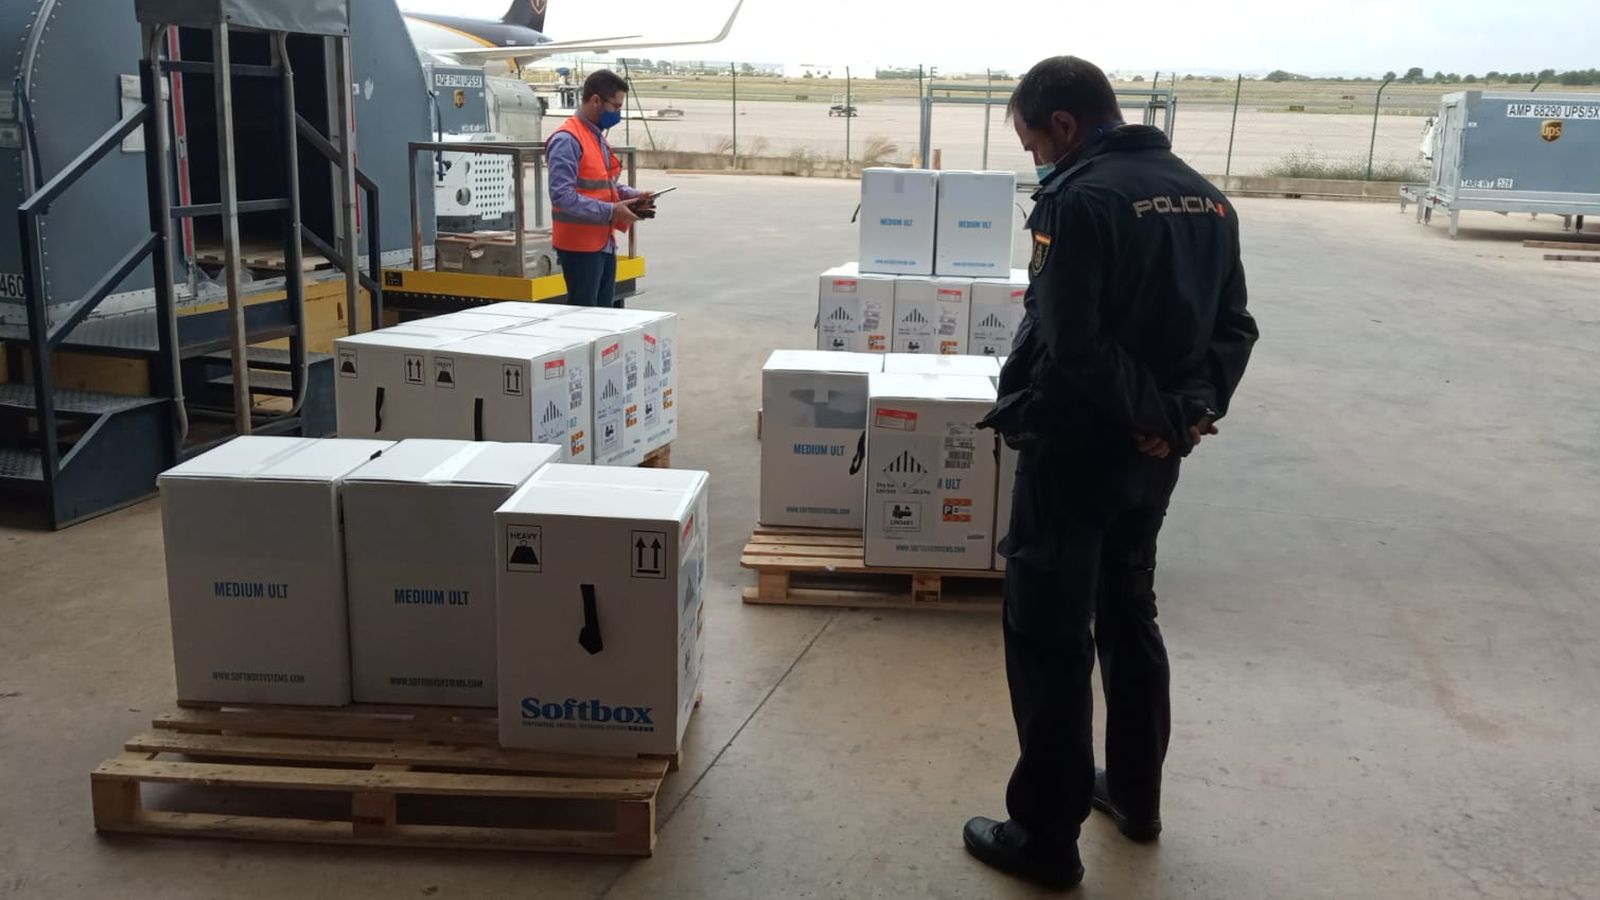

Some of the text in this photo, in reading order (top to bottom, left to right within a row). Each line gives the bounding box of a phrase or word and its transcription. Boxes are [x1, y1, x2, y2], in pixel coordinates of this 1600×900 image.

[1509, 104, 1532, 116] AMP
[1534, 105, 1561, 117] 68290
[1542, 127, 1561, 140] ups
[1133, 195, 1218, 218] POLICIA
[0, 274, 25, 297] 460
[794, 443, 846, 457] MEDIUM ULT
[945, 478, 961, 490] ULT
[510, 532, 538, 540] HEAVY
[214, 581, 289, 599] MEDIUM ULT
[394, 588, 470, 606] MEDIUM ULT
[521, 697, 654, 724] Softbox
